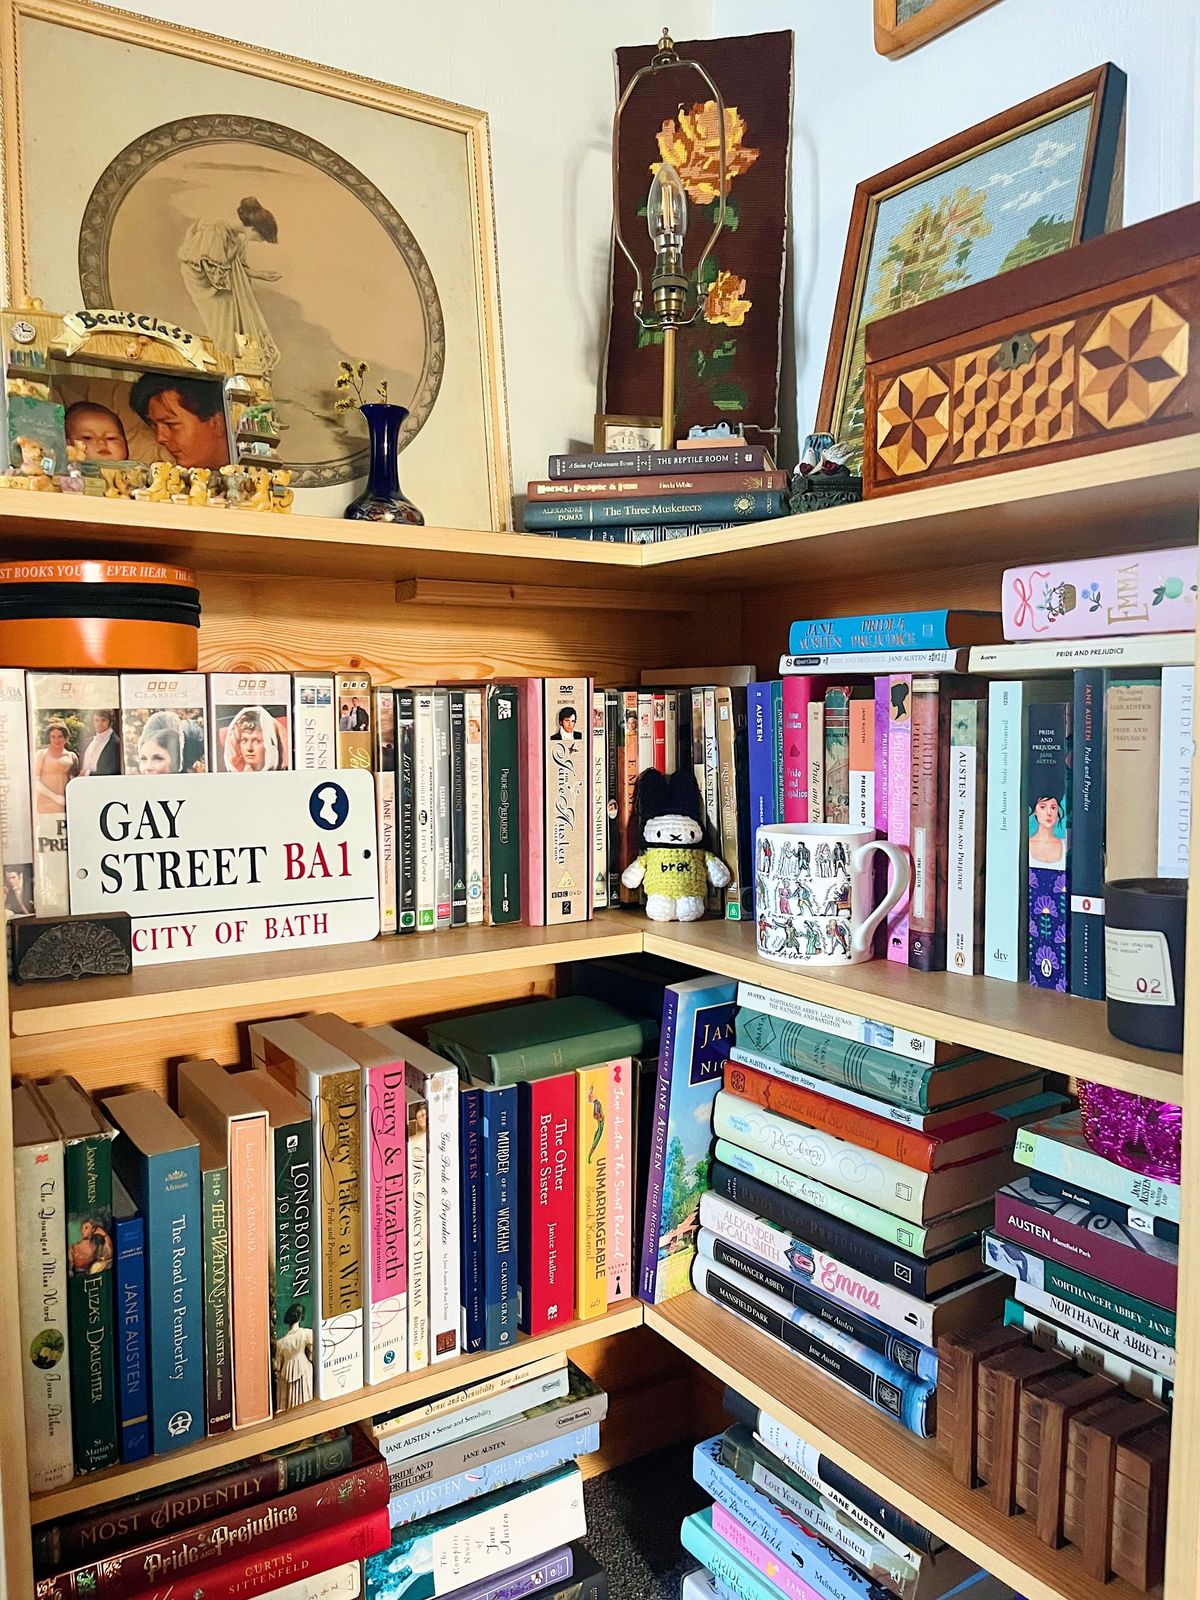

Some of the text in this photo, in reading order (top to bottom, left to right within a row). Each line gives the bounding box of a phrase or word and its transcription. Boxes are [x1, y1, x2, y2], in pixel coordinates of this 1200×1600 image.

[658, 454, 729, 465] THE REPTILE ROOM
[542, 506, 583, 515] ALEXANDRE
[558, 513, 583, 522] DUMAS
[603, 501, 703, 516] The Three Musketeers
[14, 565, 54, 578] BOOKS
[107, 565, 137, 577] EVER
[140, 566, 168, 578] HEAR
[1107, 563, 1149, 625] EMMA
[800, 636, 842, 650] AUSTEN
[805, 622, 835, 636] JANE
[852, 632, 916, 647] PREJUDICE
[1090, 647, 1124, 655] PREJUDICE
[134, 690, 189, 700] CLASSICS
[1085, 684, 1093, 706] JANE
[1180, 684, 1192, 738] PRIDE
[756, 704, 764, 742] AUSTEN
[1085, 708, 1094, 741] AUSTEN
[912, 722, 921, 812] PREJUDICE
[1032, 744, 1061, 752] PREJUDICE
[1083, 746, 1093, 765] Pride
[706, 735, 714, 808] JANE AUSTEN
[384, 799, 394, 815] JANE
[595, 756, 603, 852] SENSE SENSIBILITY
[1082, 778, 1092, 812] Prejudice
[99, 800, 187, 842] GAY
[958, 751, 968, 892] AUSTEN PRIDE AND PREJUDICE
[1176, 766, 1191, 864] PREJUDICE
[384, 817, 394, 861] AUSTEN
[101, 846, 268, 894] STREET
[283, 840, 353, 881] BA1
[661, 861, 691, 873] brat
[132, 912, 330, 952] CITY OF BATH
[993, 949, 1009, 961] dtv
[1136, 977, 1162, 994] 02
[664, 1026, 672, 1057] WORLD
[663, 1060, 668, 1072] OF
[736, 1054, 816, 1089] JANE AUSTEN Northanger Abbey
[612, 1086, 624, 1111] Jane
[658, 1074, 670, 1111] JANE
[613, 1115, 623, 1150] Austen
[654, 1115, 668, 1171] AUSTEN
[539, 1114, 552, 1206] Bennet Sister
[554, 1118, 569, 1191] The Other
[613, 1153, 624, 1178] The
[378, 1070, 405, 1282] Darcy & Elizabeth
[652, 1182, 660, 1209] NIGEL
[334, 1100, 360, 1310] Darcy Takes a Wife
[613, 1181, 624, 1211] Secret
[277, 1195, 290, 1275] JO BAKER
[290, 1160, 310, 1299] LONGBOURN
[595, 1157, 607, 1280] UNMARRIAGEABLE
[612, 1215, 624, 1259] Radical
[648, 1211, 659, 1254] NICOLSON
[723, 1210, 776, 1245] ALEXANDER
[1007, 1214, 1091, 1258] AUSTEN Mansfield Park
[547, 1222, 557, 1285] Janice Hadlow
[169, 1214, 188, 1381] The Road to Pemberley
[721, 1252, 855, 1333] NORTHANGER ABBEY Jane Austen
[819, 1254, 881, 1310] Emma
[1051, 1276, 1173, 1338] NORTHANGER ABBEY JANE
[84, 1275, 108, 1405] ELIZA'S DAUGHTER
[123, 1282, 140, 1394] JANE AUSTEN
[719, 1287, 841, 1370] MANSFIELD PARK Jane Austen
[1050, 1297, 1159, 1361] NORTHANGER ABBEY
[385, 1408, 492, 1454] JANE AUSTEN Sense and Sensibility
[462, 1440, 506, 1463] JANE AUSTEN
[389, 1460, 434, 1484] PRIDE AND
[389, 1470, 434, 1492] PREJUDICE
[80, 1476, 264, 1546] MOST ARDENTLY
[763, 1473, 866, 1558] Lost Years of Jane Austen
[780, 1452, 886, 1540] Persuasion JANE AUSTEN
[143, 1504, 299, 1583] Pride Prejudice
[486, 1526, 500, 1555] Jane
[500, 1512, 512, 1555] Austen
[244, 1552, 294, 1578] CURTIS
[440, 1550, 448, 1567] The
[453, 1535, 461, 1575] Complete
[712, 1553, 744, 1589] PRIDE
[228, 1559, 310, 1595] SITTENFELD
